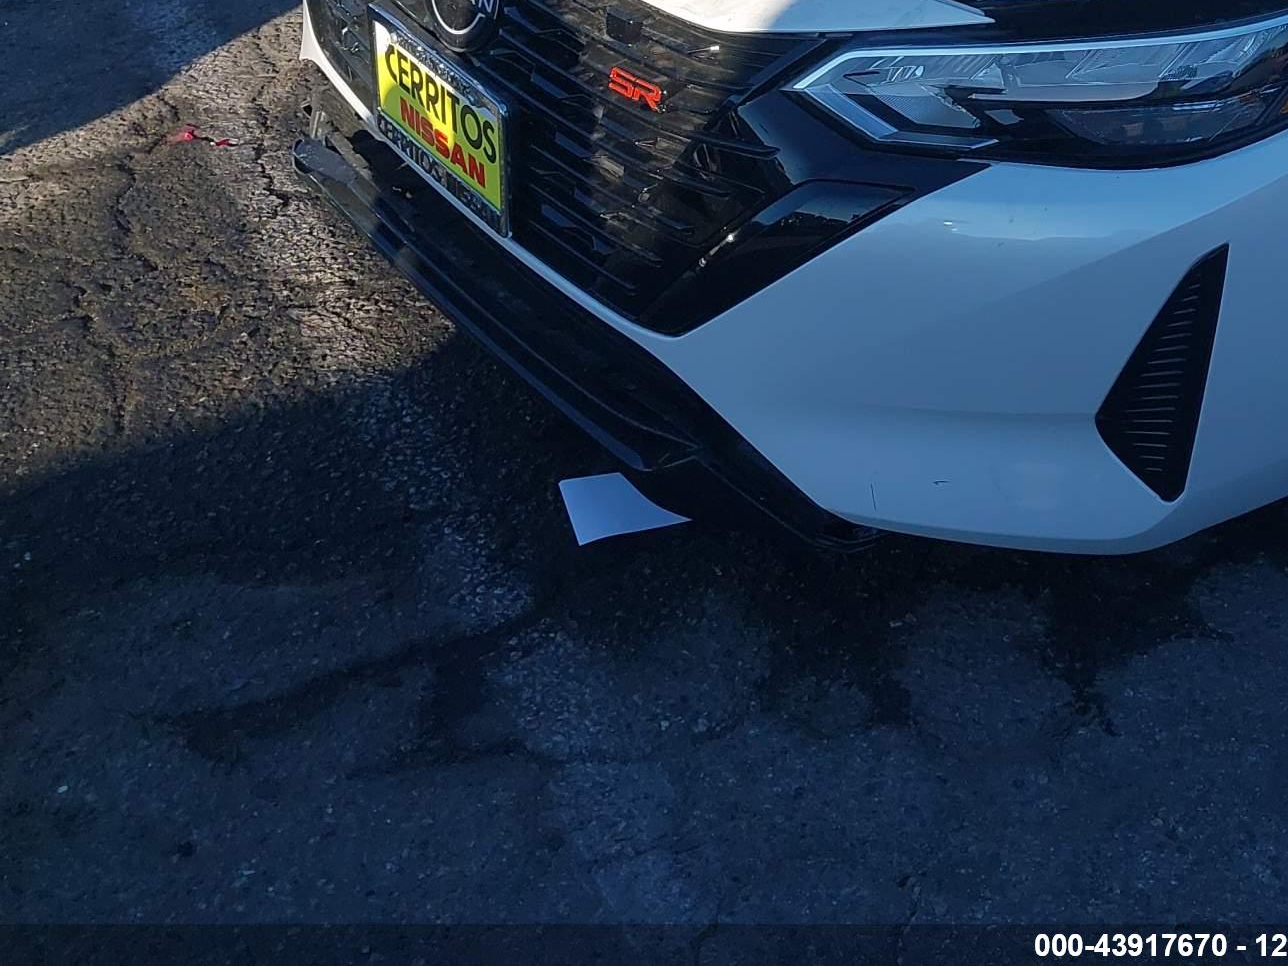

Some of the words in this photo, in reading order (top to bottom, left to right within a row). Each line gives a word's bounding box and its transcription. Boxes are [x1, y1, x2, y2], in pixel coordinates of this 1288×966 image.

[385, 44, 496, 164] CERRITOS
[609, 67, 661, 112] SR
[400, 97, 486, 188] NISSAN
